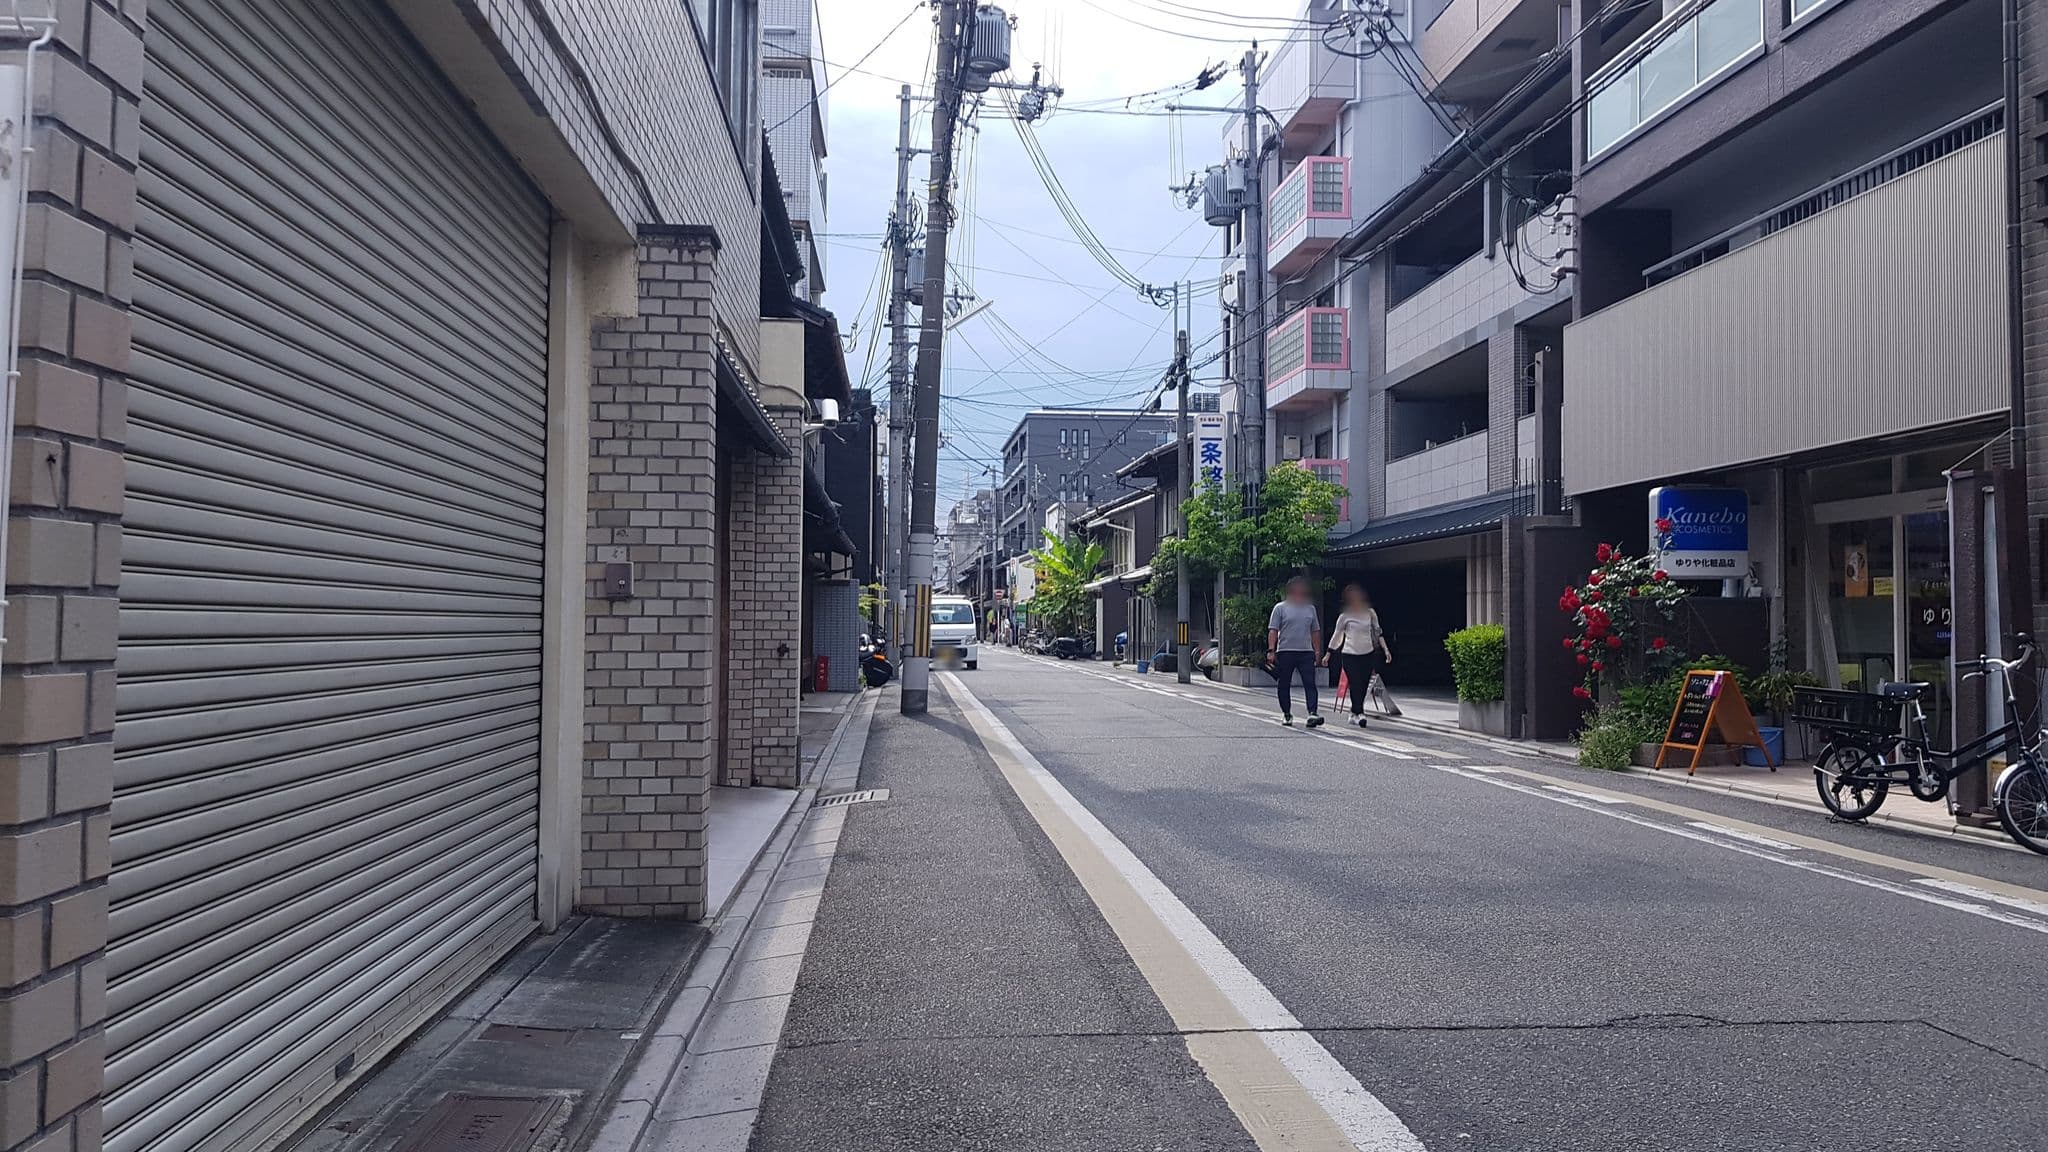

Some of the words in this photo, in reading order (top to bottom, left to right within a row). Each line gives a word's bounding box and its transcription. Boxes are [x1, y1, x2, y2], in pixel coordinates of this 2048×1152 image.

[1667, 506, 1746, 523] Kanebo
[1679, 524, 1732, 534] COSMETICS
[1676, 558, 1735, 567] ゆりや化粧品店
